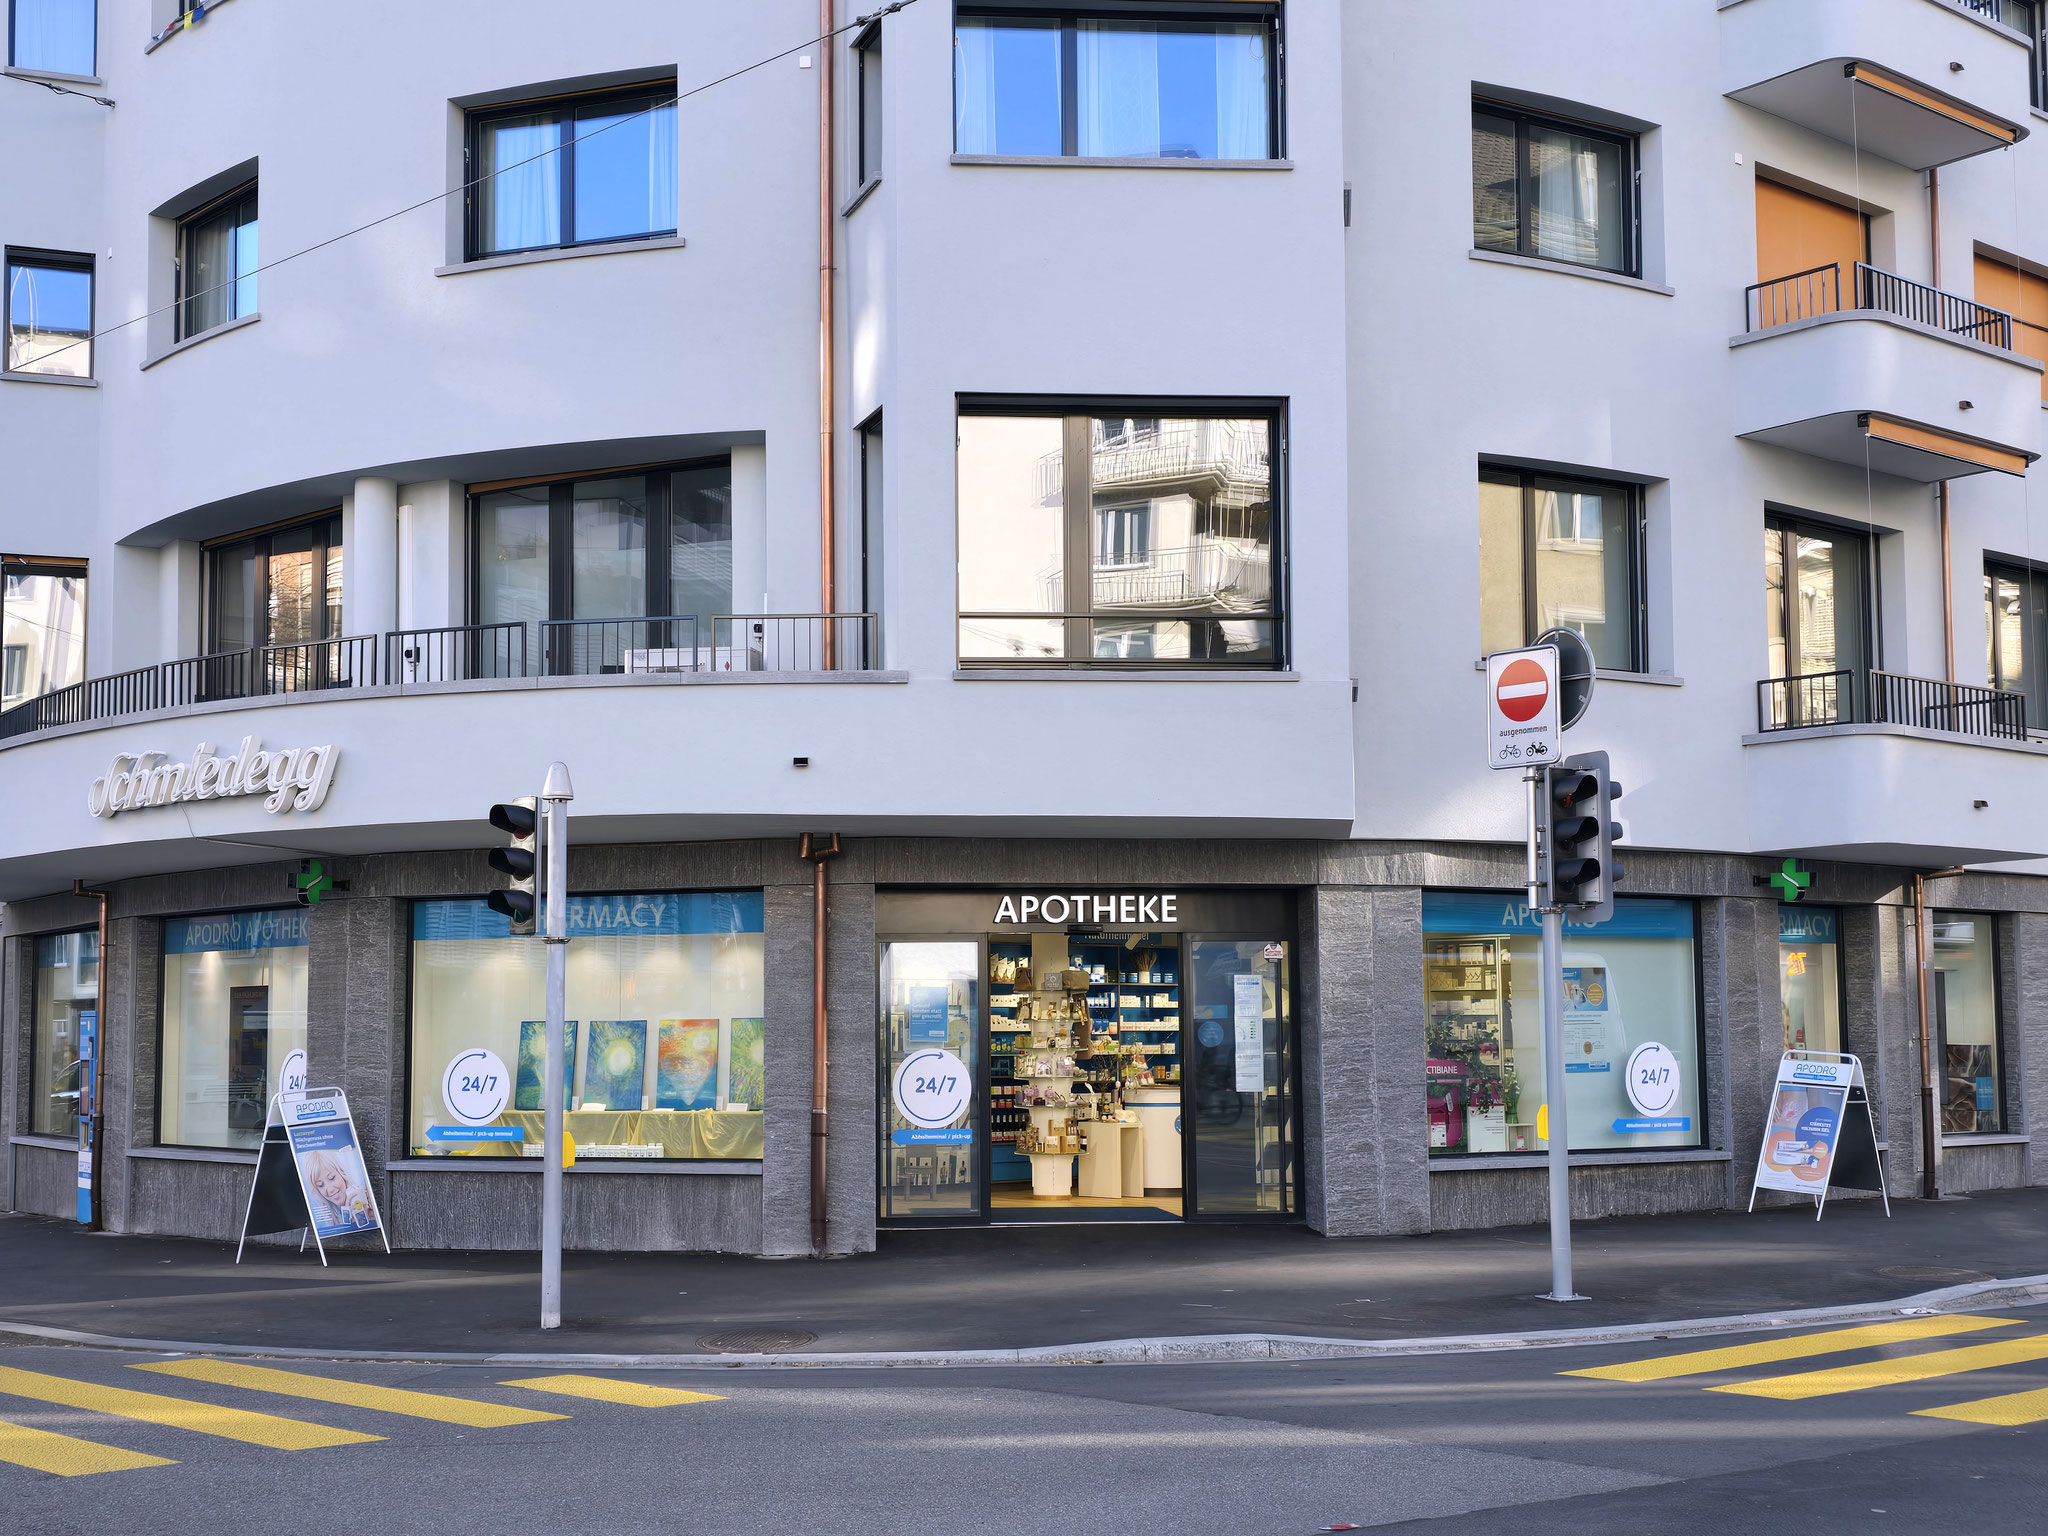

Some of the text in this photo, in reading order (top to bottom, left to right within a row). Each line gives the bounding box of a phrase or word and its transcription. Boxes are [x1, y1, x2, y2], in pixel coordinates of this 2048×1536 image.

[1499, 725, 1548, 738] ausgenommen
[88, 735, 340, 819] Schmiedegg
[993, 894, 1178, 924] APOTHEKE
[185, 921, 241, 946] APODRO
[1641, 1067, 1670, 1087] 24/7
[1795, 1063, 1838, 1076] APODRO
[461, 1074, 498, 1095] 24/7
[915, 1075, 957, 1096] 24/7
[295, 1100, 334, 1114] APODRO
